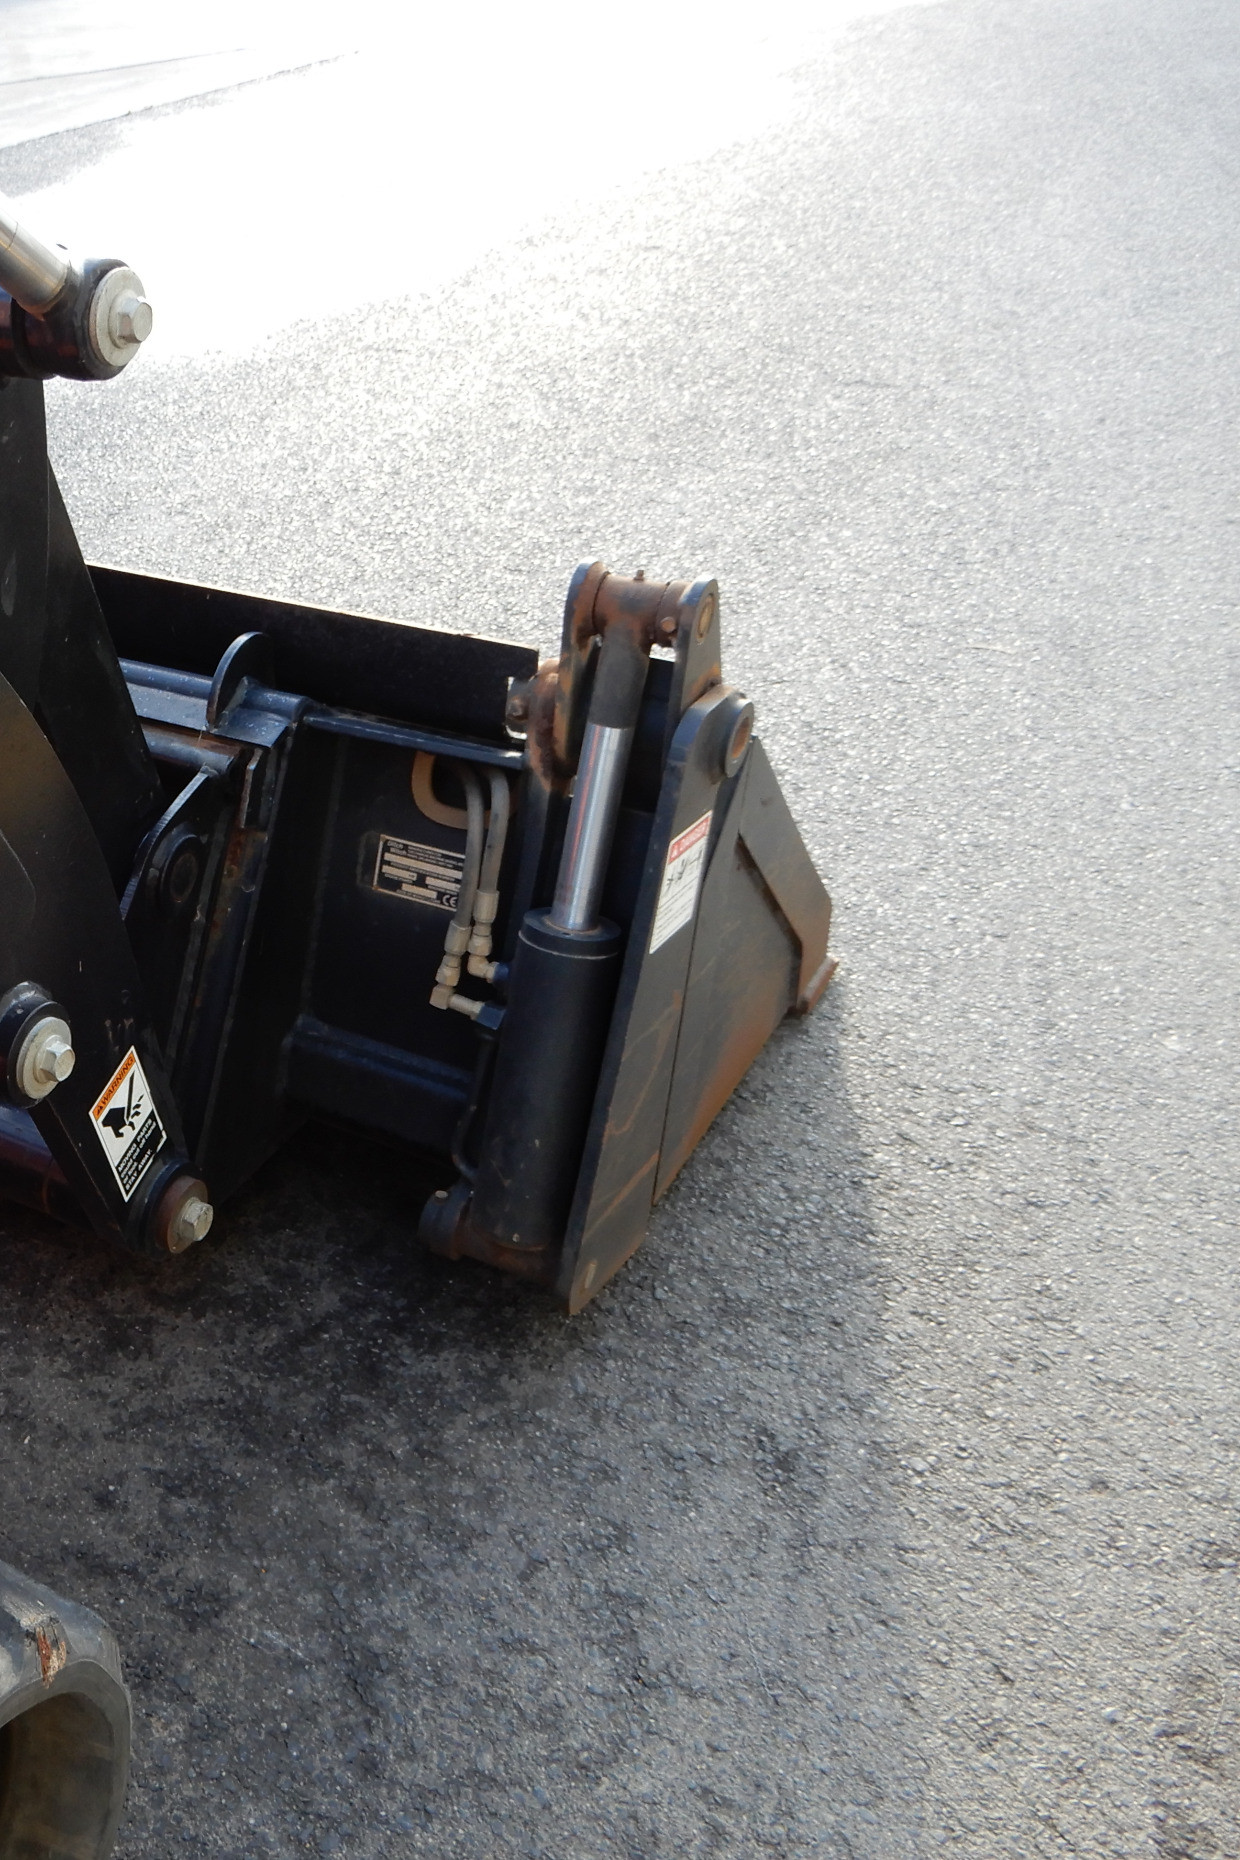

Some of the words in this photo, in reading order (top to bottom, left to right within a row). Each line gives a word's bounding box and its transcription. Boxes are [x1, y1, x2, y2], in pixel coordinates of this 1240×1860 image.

[442, 894, 457, 908] CE
[101, 1055, 134, 1106] WARNING
[118, 1141, 137, 1173] MOVING
